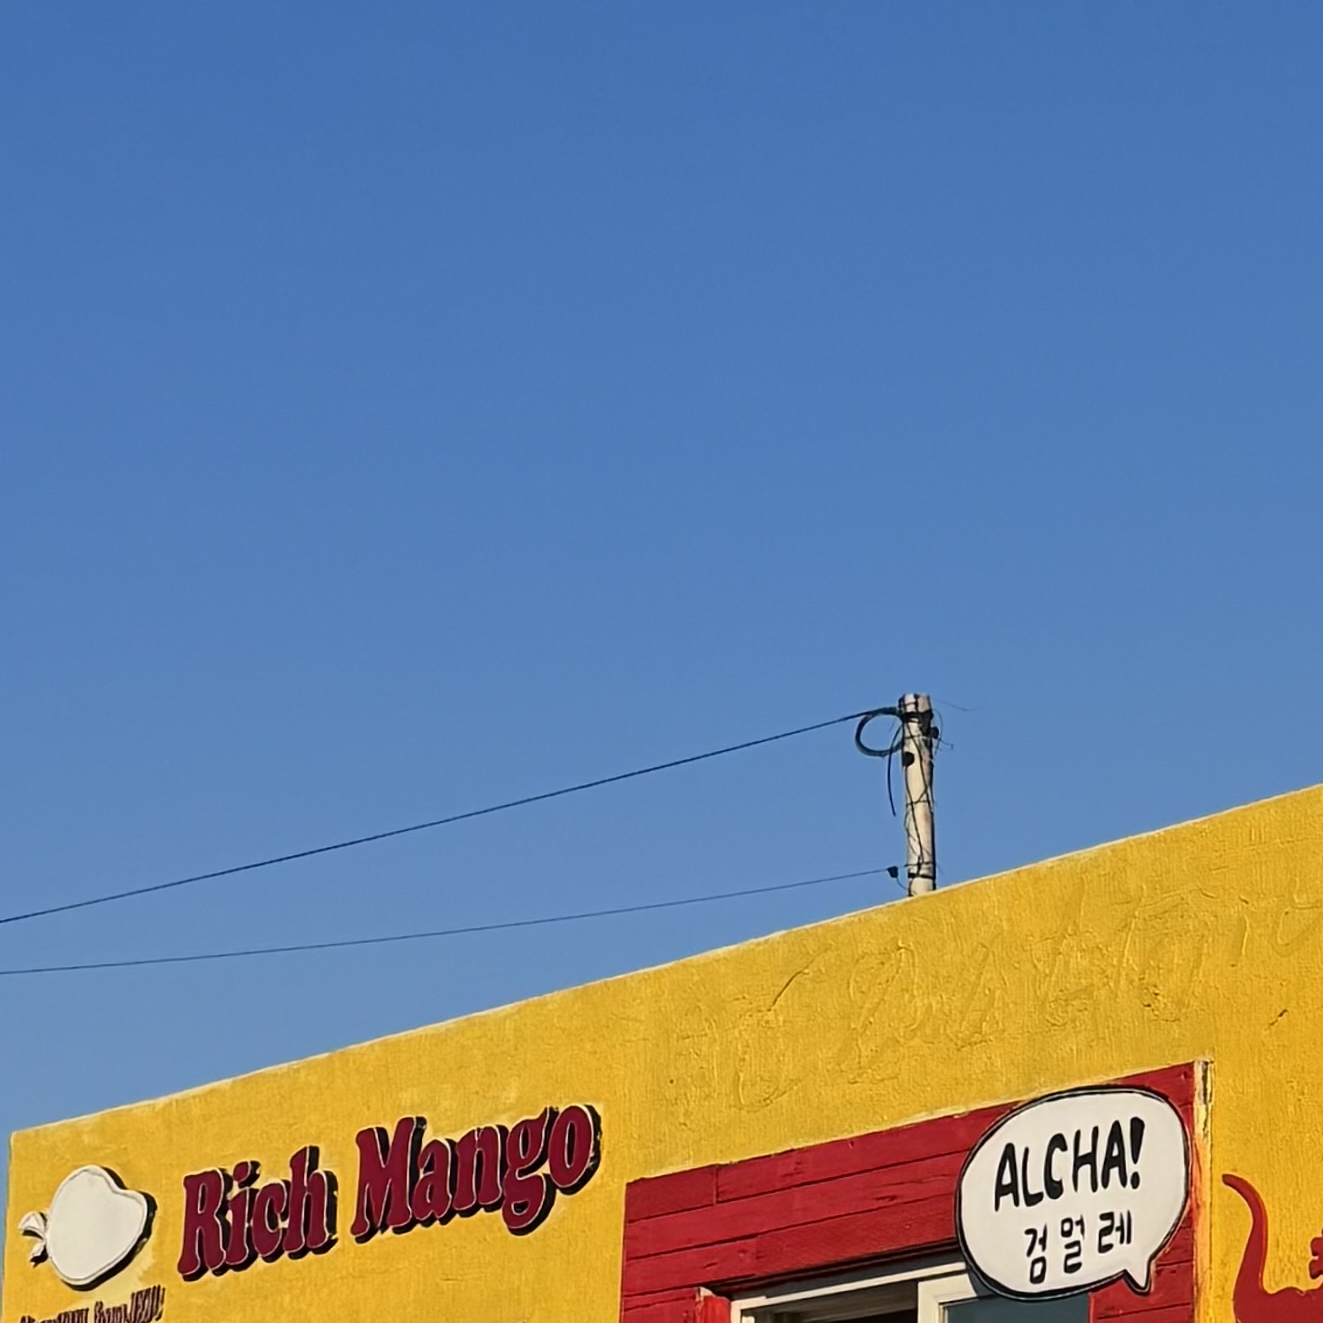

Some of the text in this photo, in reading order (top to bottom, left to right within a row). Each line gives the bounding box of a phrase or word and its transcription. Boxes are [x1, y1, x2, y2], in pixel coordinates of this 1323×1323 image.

[178, 1103, 602, 1281] Rich Mango
[994, 1117, 1146, 1212] ALCHA!
